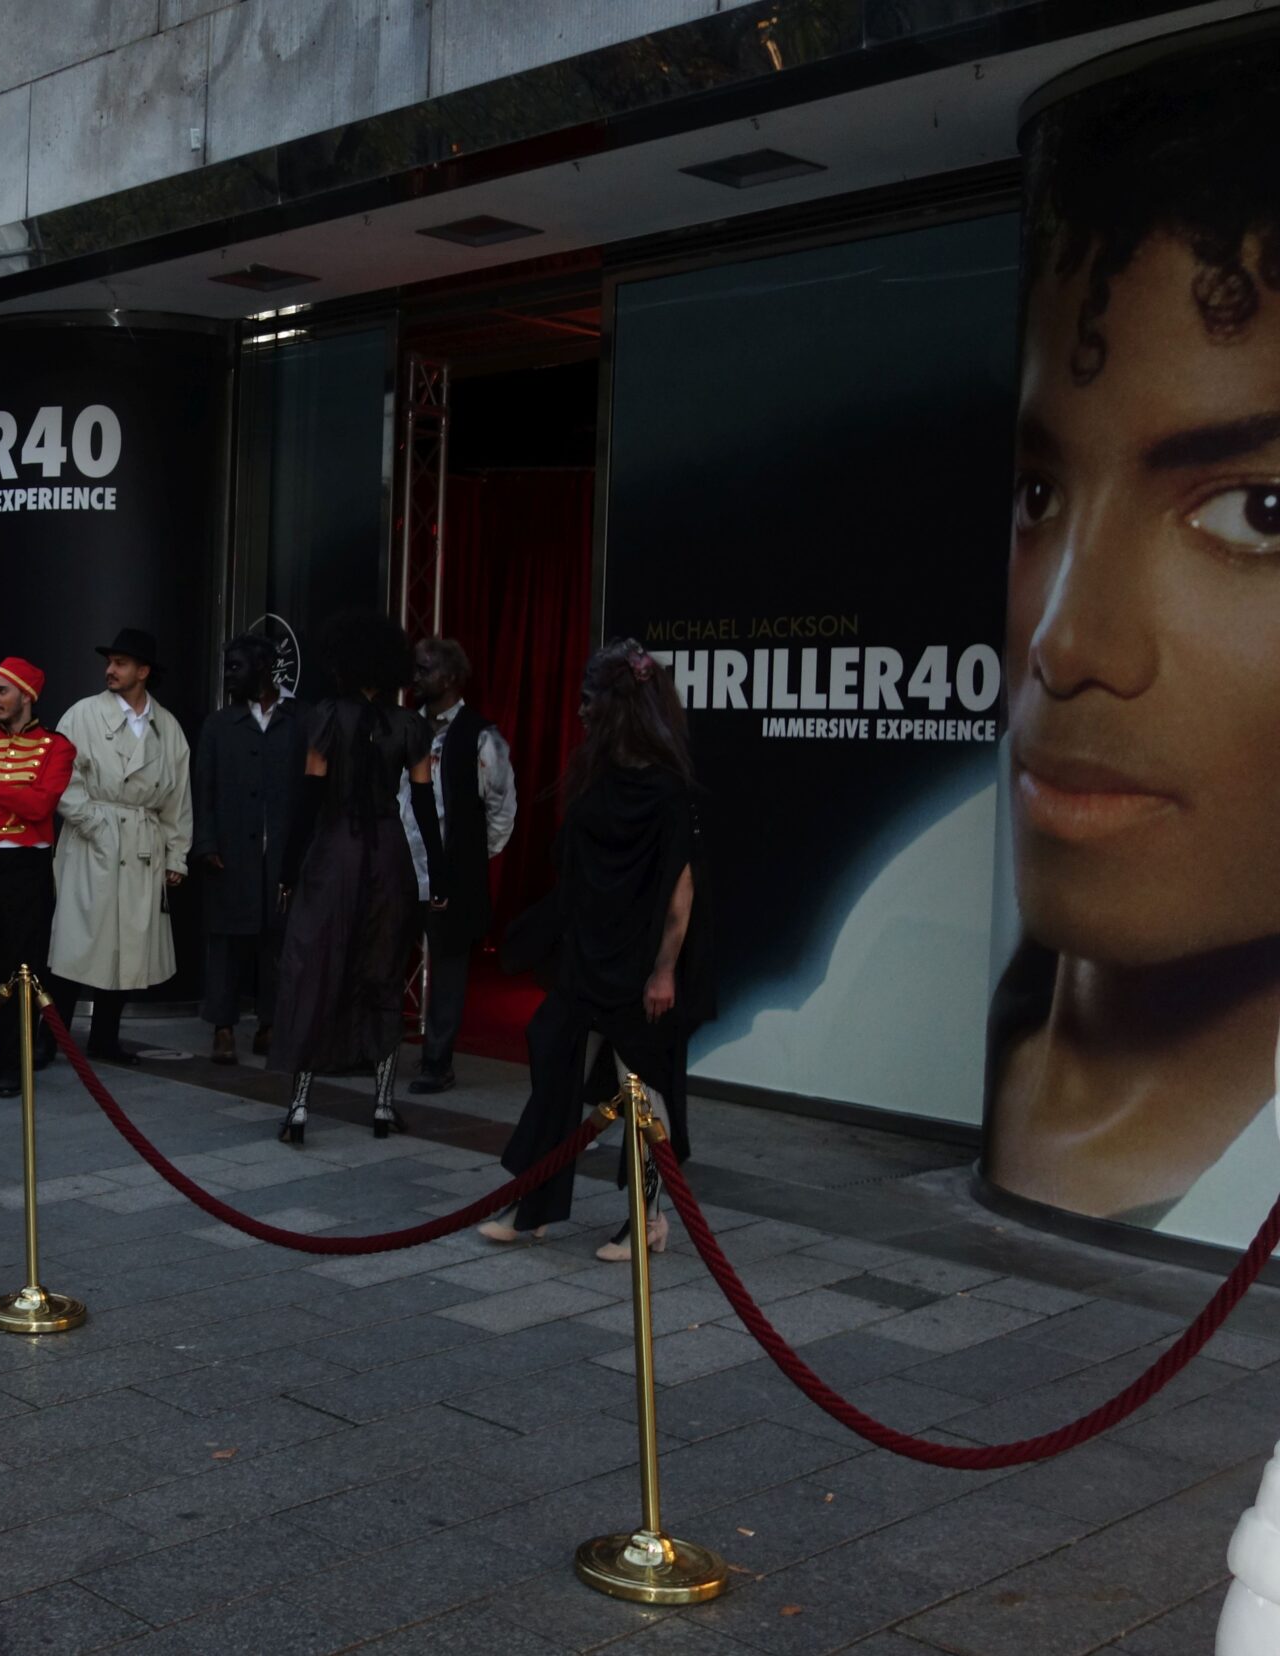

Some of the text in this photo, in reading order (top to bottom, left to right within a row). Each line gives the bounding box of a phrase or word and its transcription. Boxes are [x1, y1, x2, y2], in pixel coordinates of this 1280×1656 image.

[645, 613, 860, 641] MICHAEL JACKSON
[762, 716, 996, 741] IMMERSIVE EXPERIENCE
